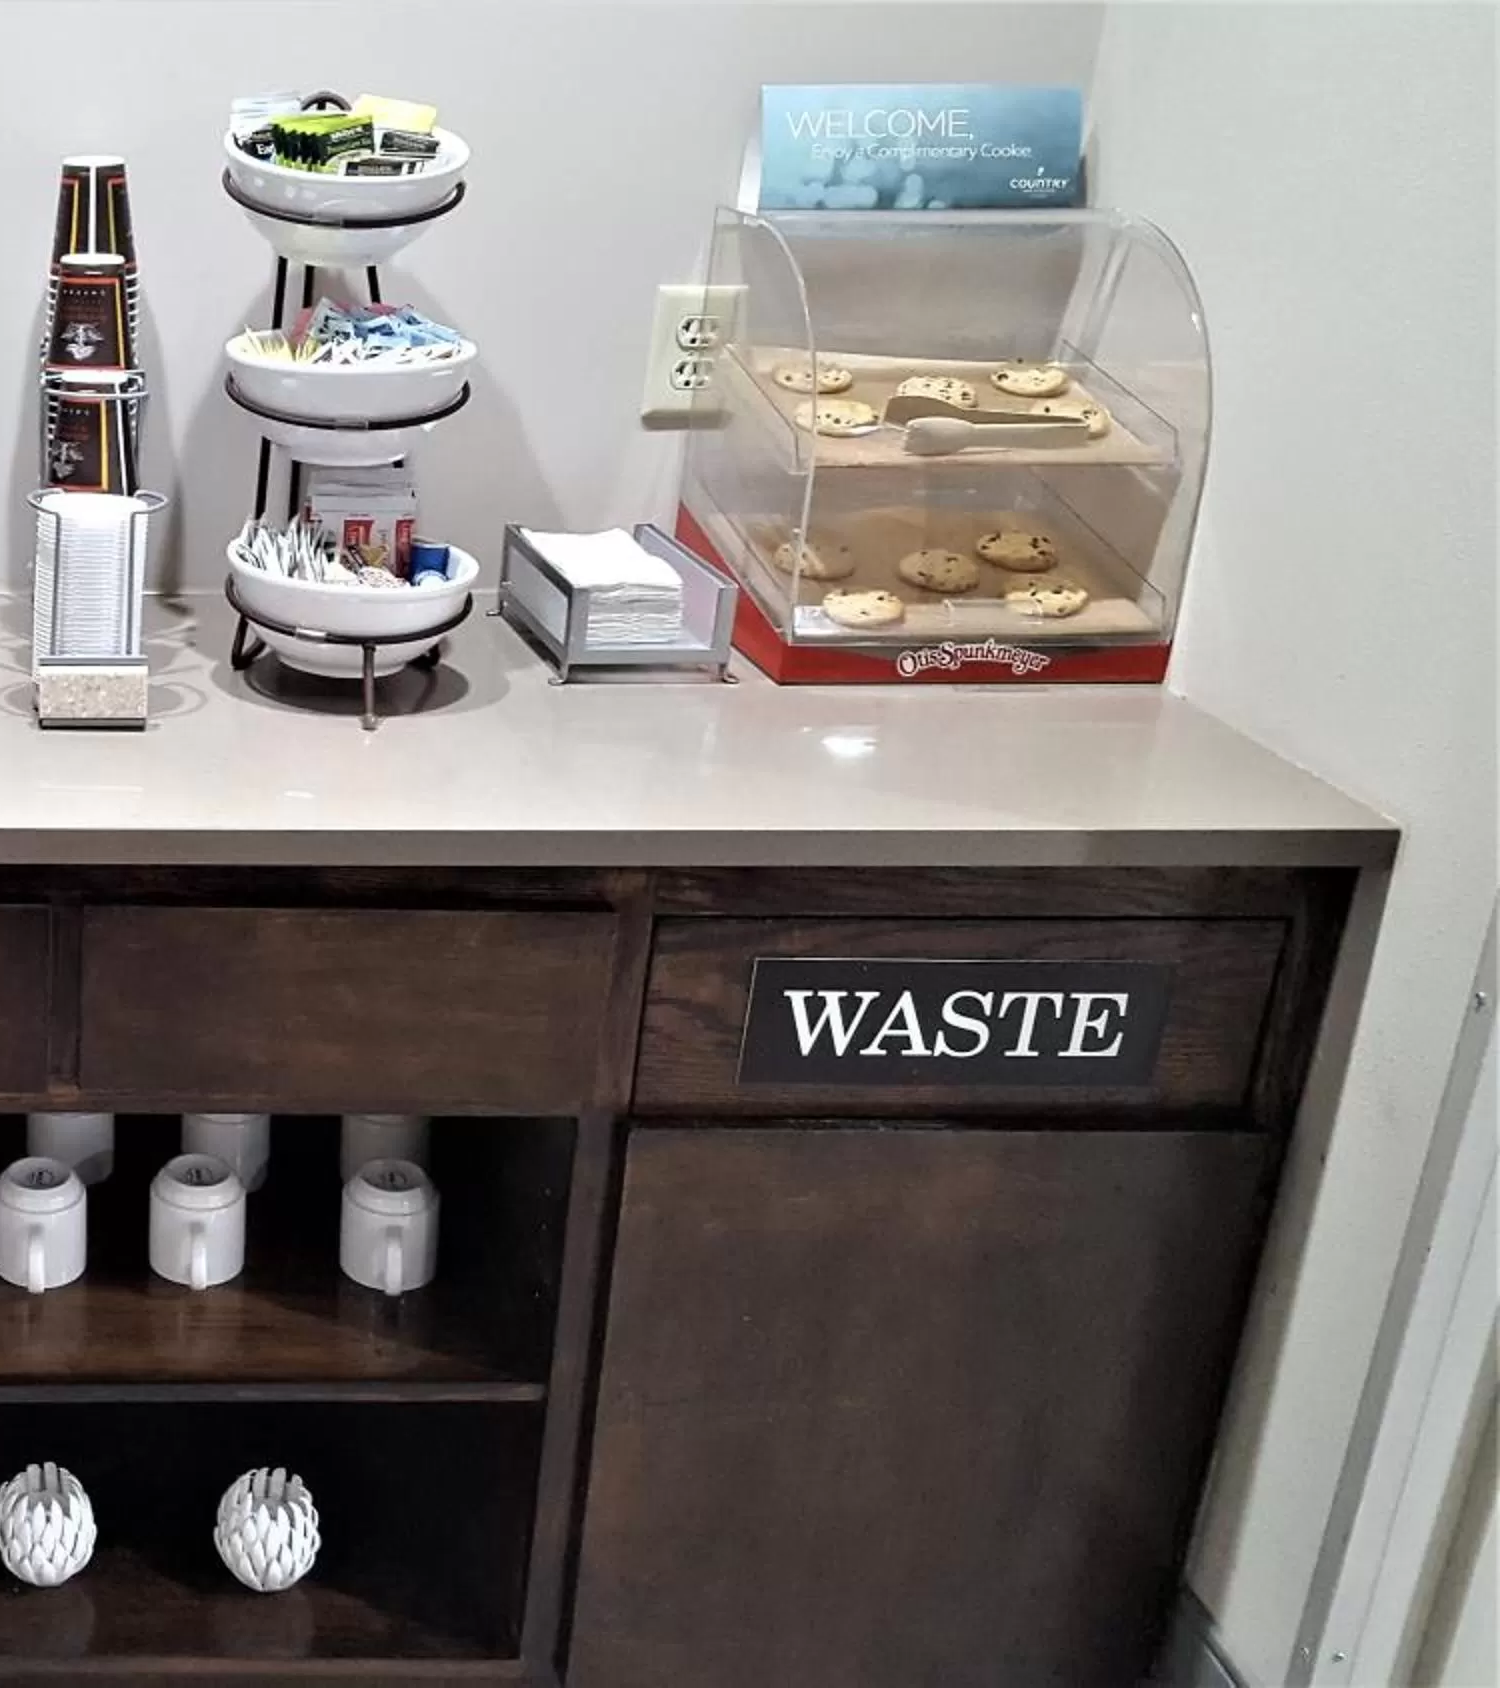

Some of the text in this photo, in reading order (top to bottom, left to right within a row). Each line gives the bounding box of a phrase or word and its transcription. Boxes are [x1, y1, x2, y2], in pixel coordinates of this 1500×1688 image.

[786, 108, 974, 140] WELCOME,
[811, 143, 852, 164] Enjoy
[866, 143, 978, 163] Complimentary
[784, 990, 1129, 1058] WASTE
